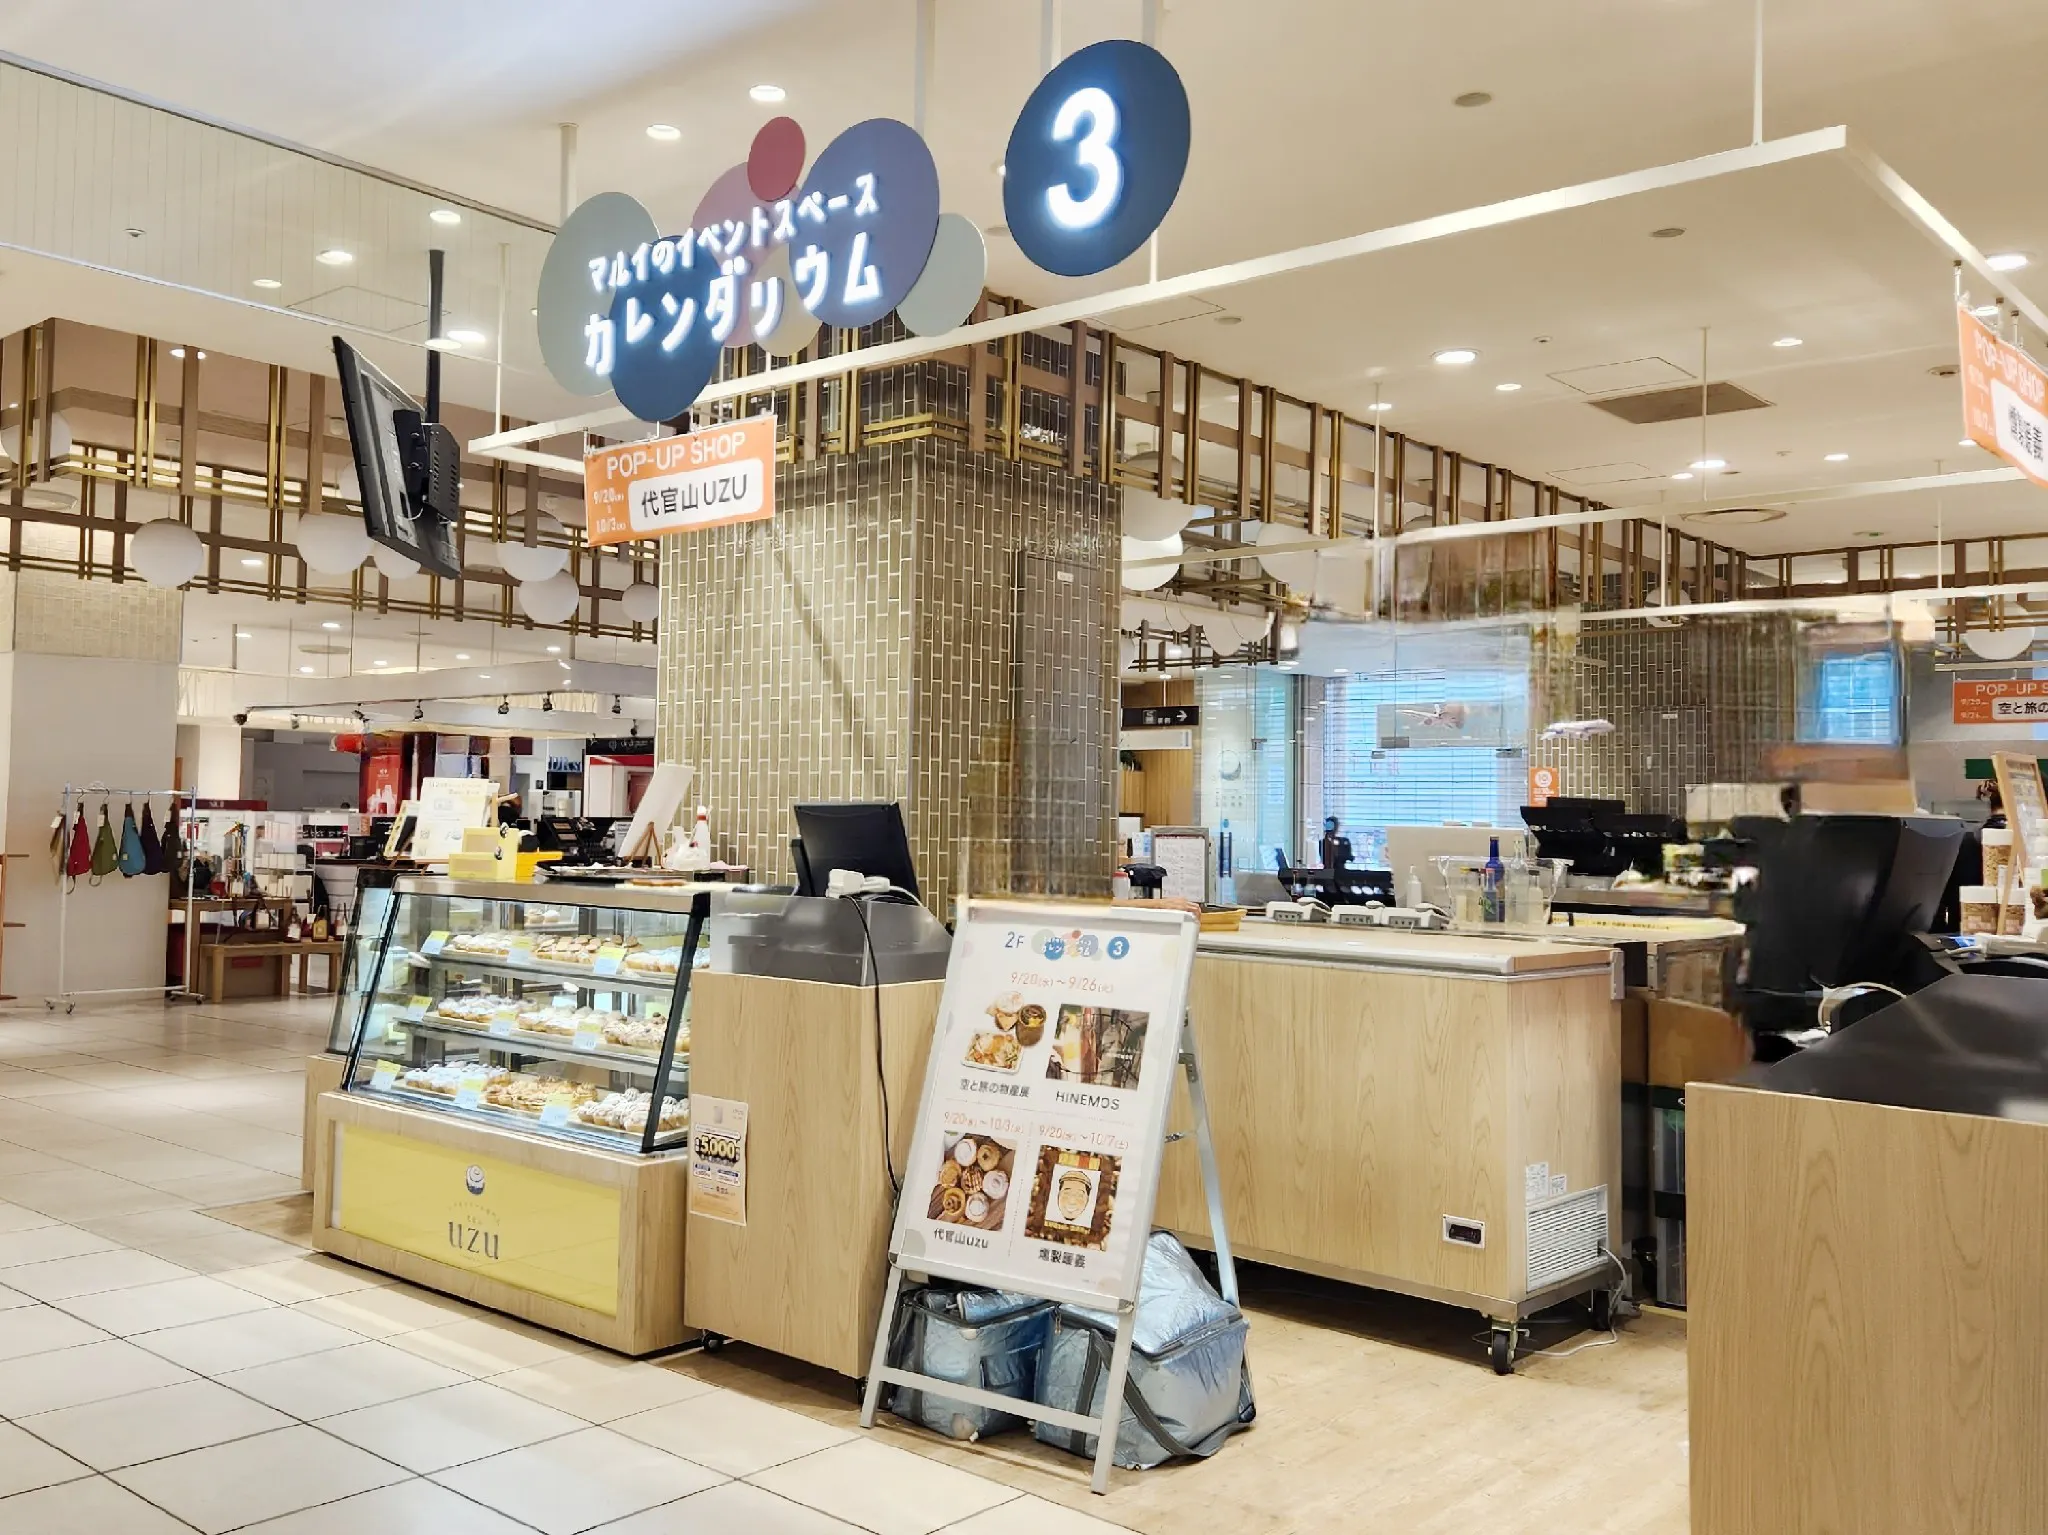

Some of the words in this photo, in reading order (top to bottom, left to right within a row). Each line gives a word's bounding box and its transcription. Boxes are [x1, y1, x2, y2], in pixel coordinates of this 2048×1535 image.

[1045, 86, 1122, 229] 3
[588, 172, 881, 292] マルイのイベントスペース
[584, 231, 882, 375] カレンダリウム
[606, 443, 685, 480] POP-UP
[690, 431, 746, 465] SHOP
[641, 473, 748, 518] 代官山UZU
[1975, 683, 2037, 696] POP-UP
[1004, 930, 1025, 949] 2F
[1112, 940, 1124, 956] 3
[1055, 1090, 1121, 1111] HINEMOS
